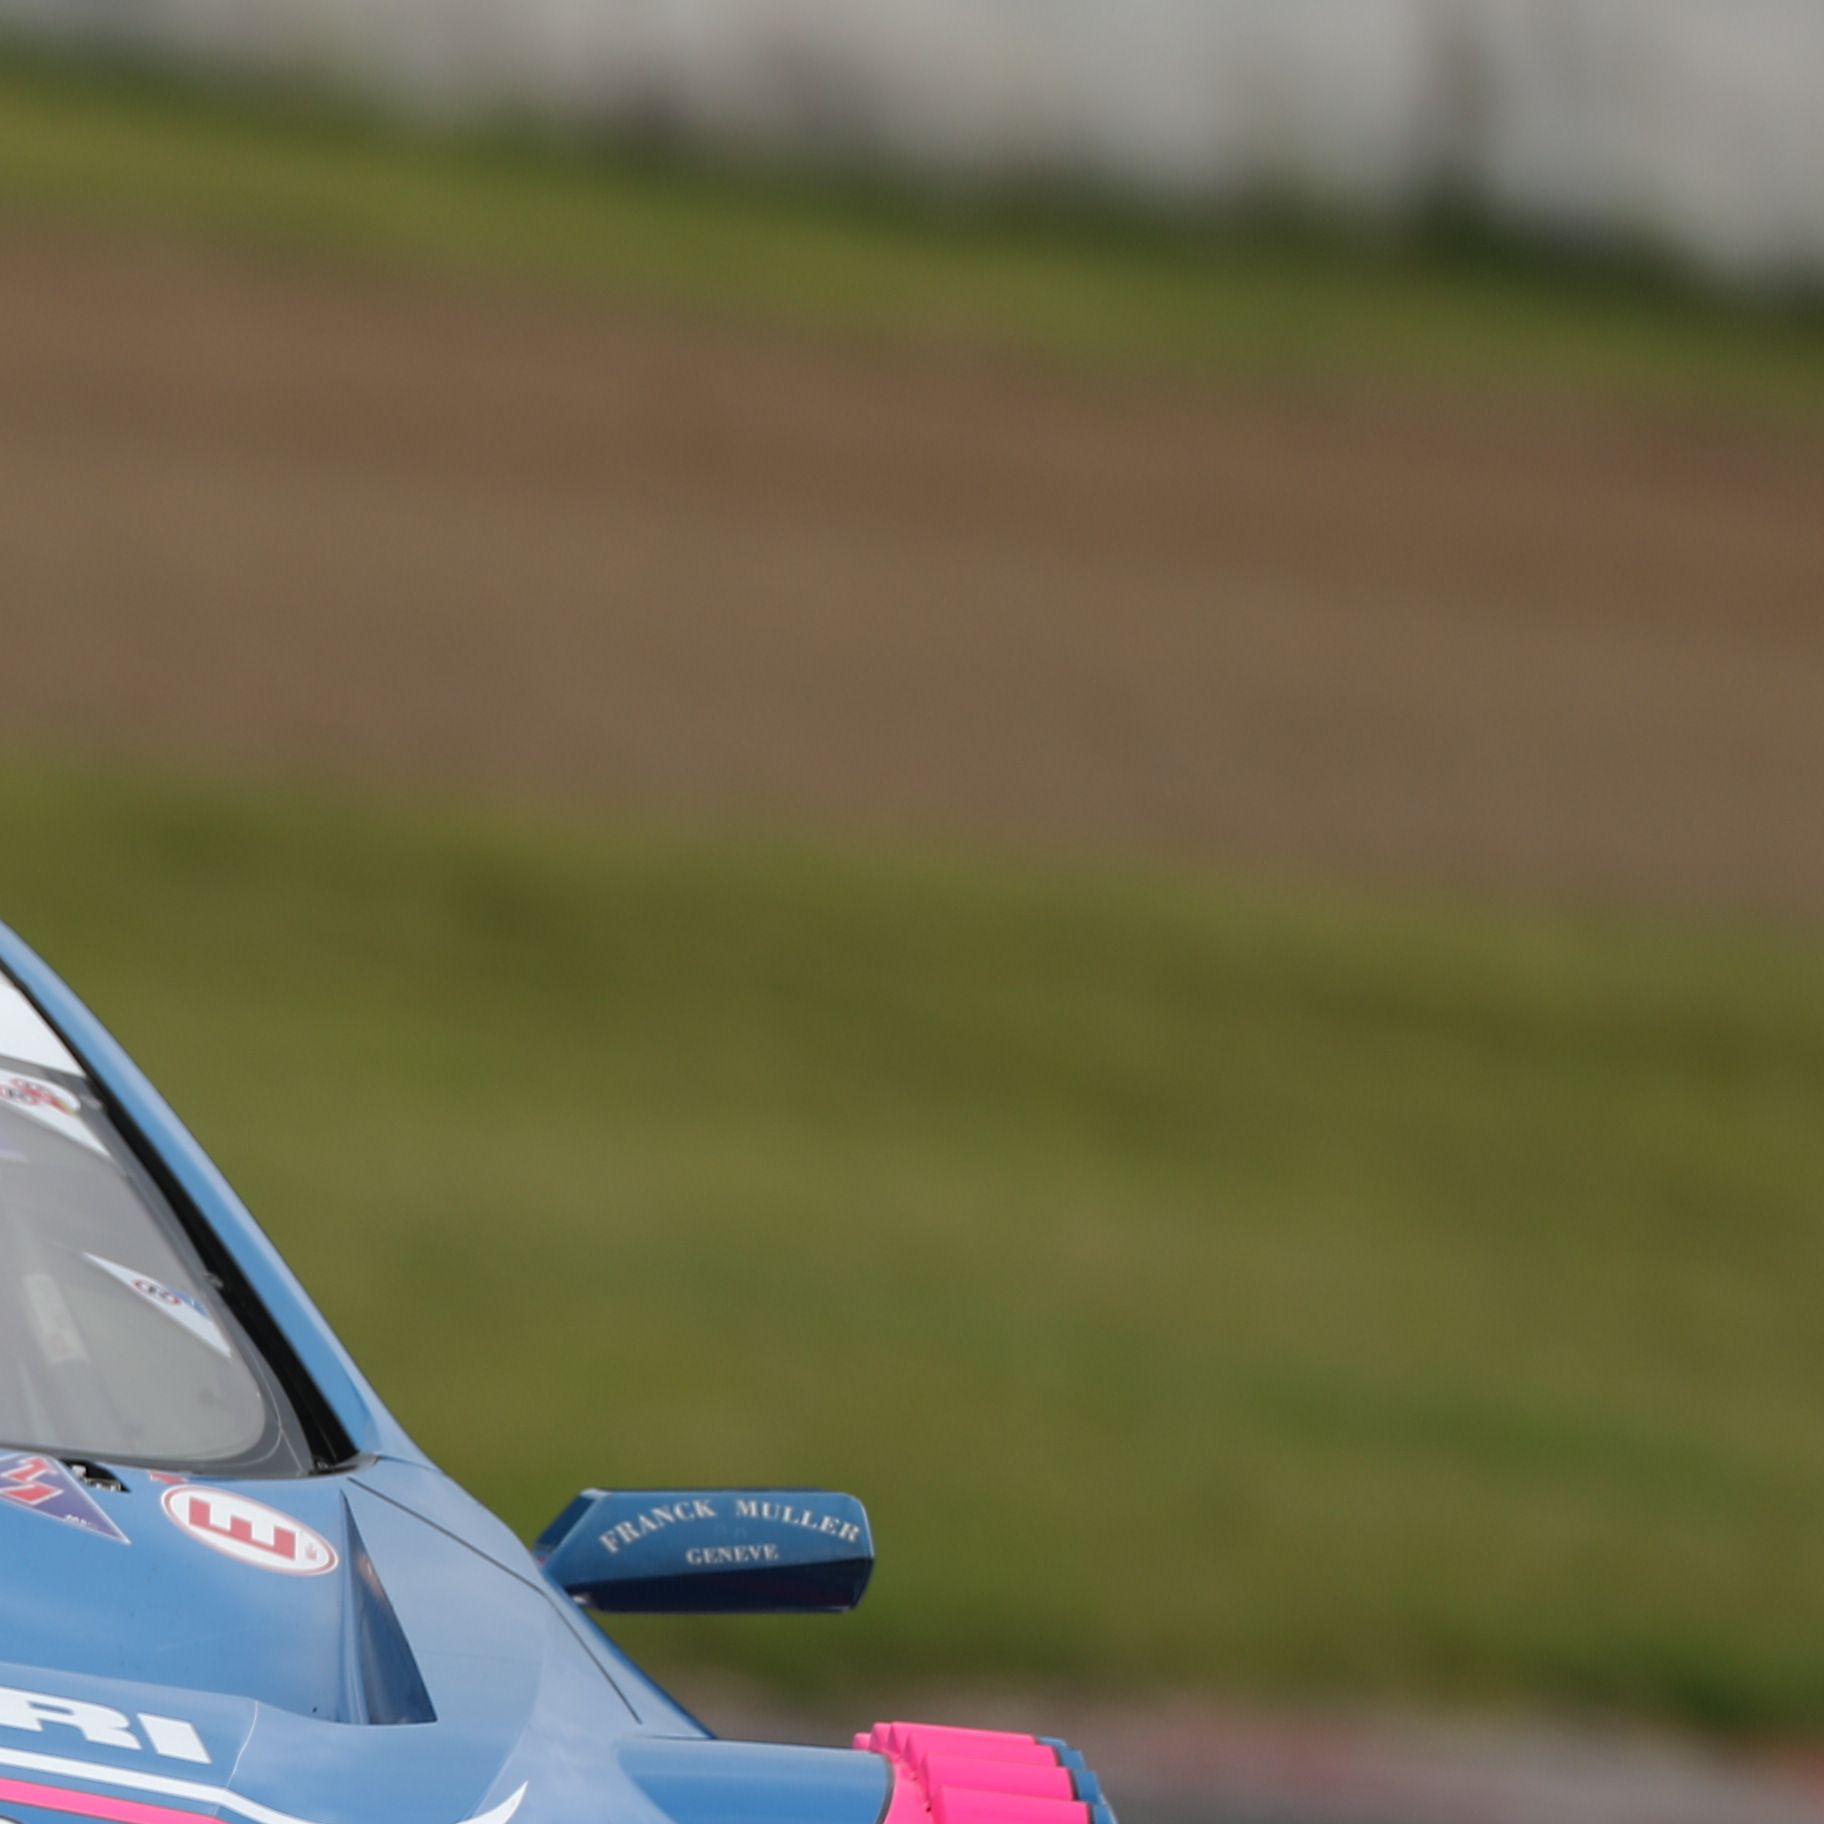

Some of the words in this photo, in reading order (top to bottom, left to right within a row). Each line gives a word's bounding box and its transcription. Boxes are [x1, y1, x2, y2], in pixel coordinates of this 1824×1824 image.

[598, 1499, 717, 1554] FRANCK
[734, 1498, 861, 1544] MULLER
[685, 1543, 781, 1566] GENEVE
